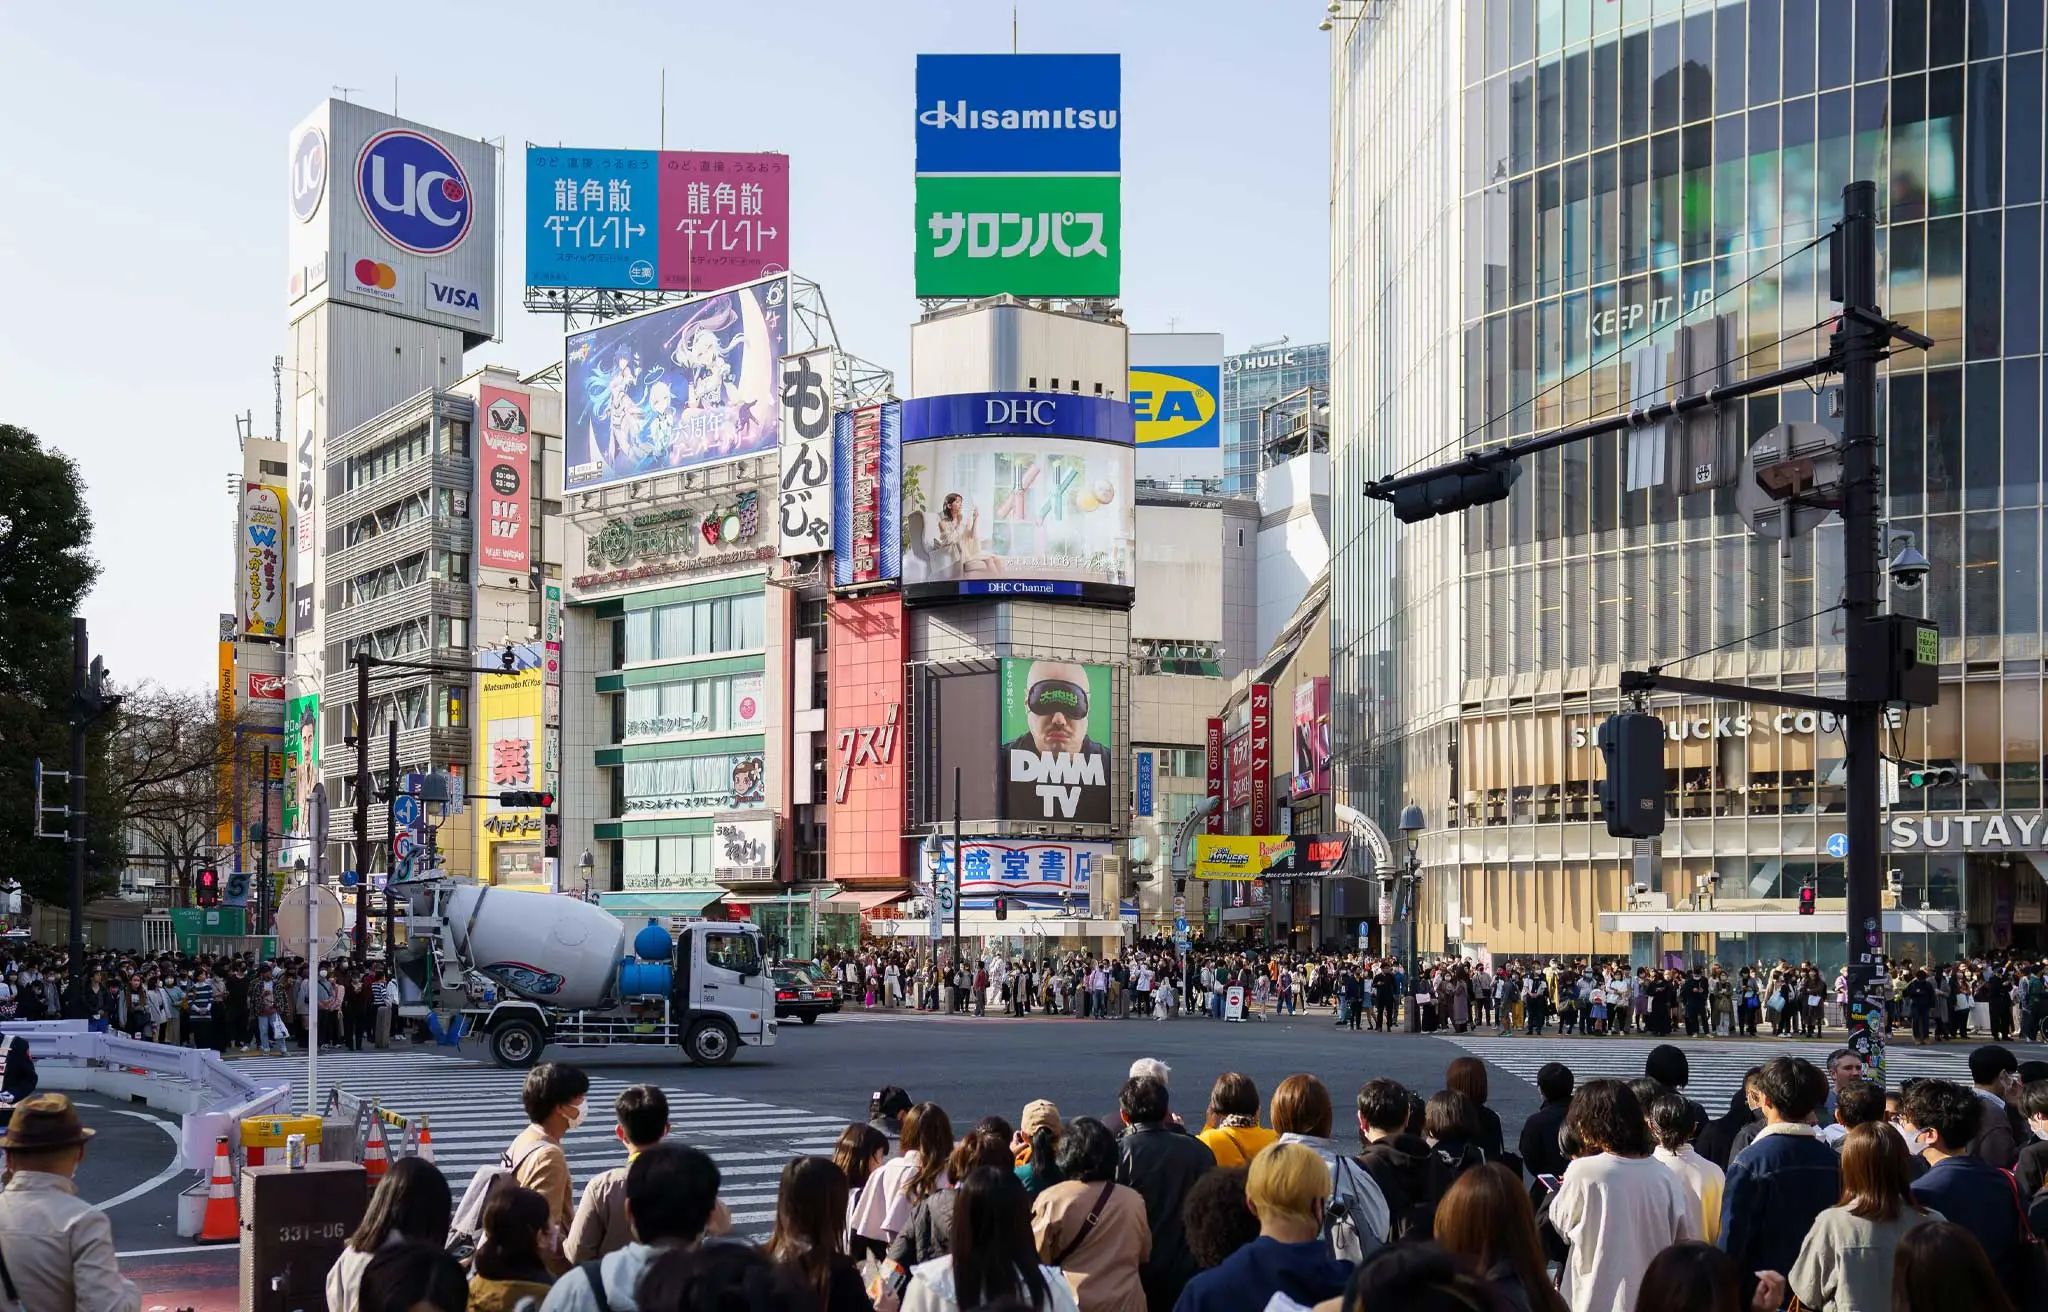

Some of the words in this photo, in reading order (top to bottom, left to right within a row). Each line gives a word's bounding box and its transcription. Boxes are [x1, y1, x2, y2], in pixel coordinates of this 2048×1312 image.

[920, 100, 1117, 129] Hisamitsu
[372, 154, 461, 227] UC
[555, 178, 632, 213] 龍角散
[687, 181, 764, 216] 龍角散
[544, 215, 646, 249] ダイレクト
[676, 218, 777, 252] ダイレクト
[929, 211, 1108, 258] サロンパス
[355, 284, 396, 300] mastercard
[430, 281, 480, 311] VISA
[1586, 303, 1644, 338] KEEP
[1652, 296, 1673, 324] IT
[1244, 351, 1295, 370] HULIC
[985, 400, 1057, 426] DHC
[1130, 390, 1204, 422] EA
[780, 356, 830, 547] もんじゃ
[492, 500, 519, 519] B1F
[491, 519, 520, 538] B2F
[987, 582, 1012, 593] DHC
[1013, 582, 1055, 593] Channel
[298, 597, 311, 618] 7F
[522, 677, 542, 689] KiYos
[1253, 694, 1268, 771] カラオケ
[1570, 713, 1753, 749] SUCKS
[1774, 707, 1903, 735] COFE
[493, 737, 530, 786] 薬
[1011, 749, 1106, 786] DMM
[1234, 738, 1249, 766] カラオ
[1036, 785, 1081, 818] TV
[1880, 814, 2048, 848] SUTAY
